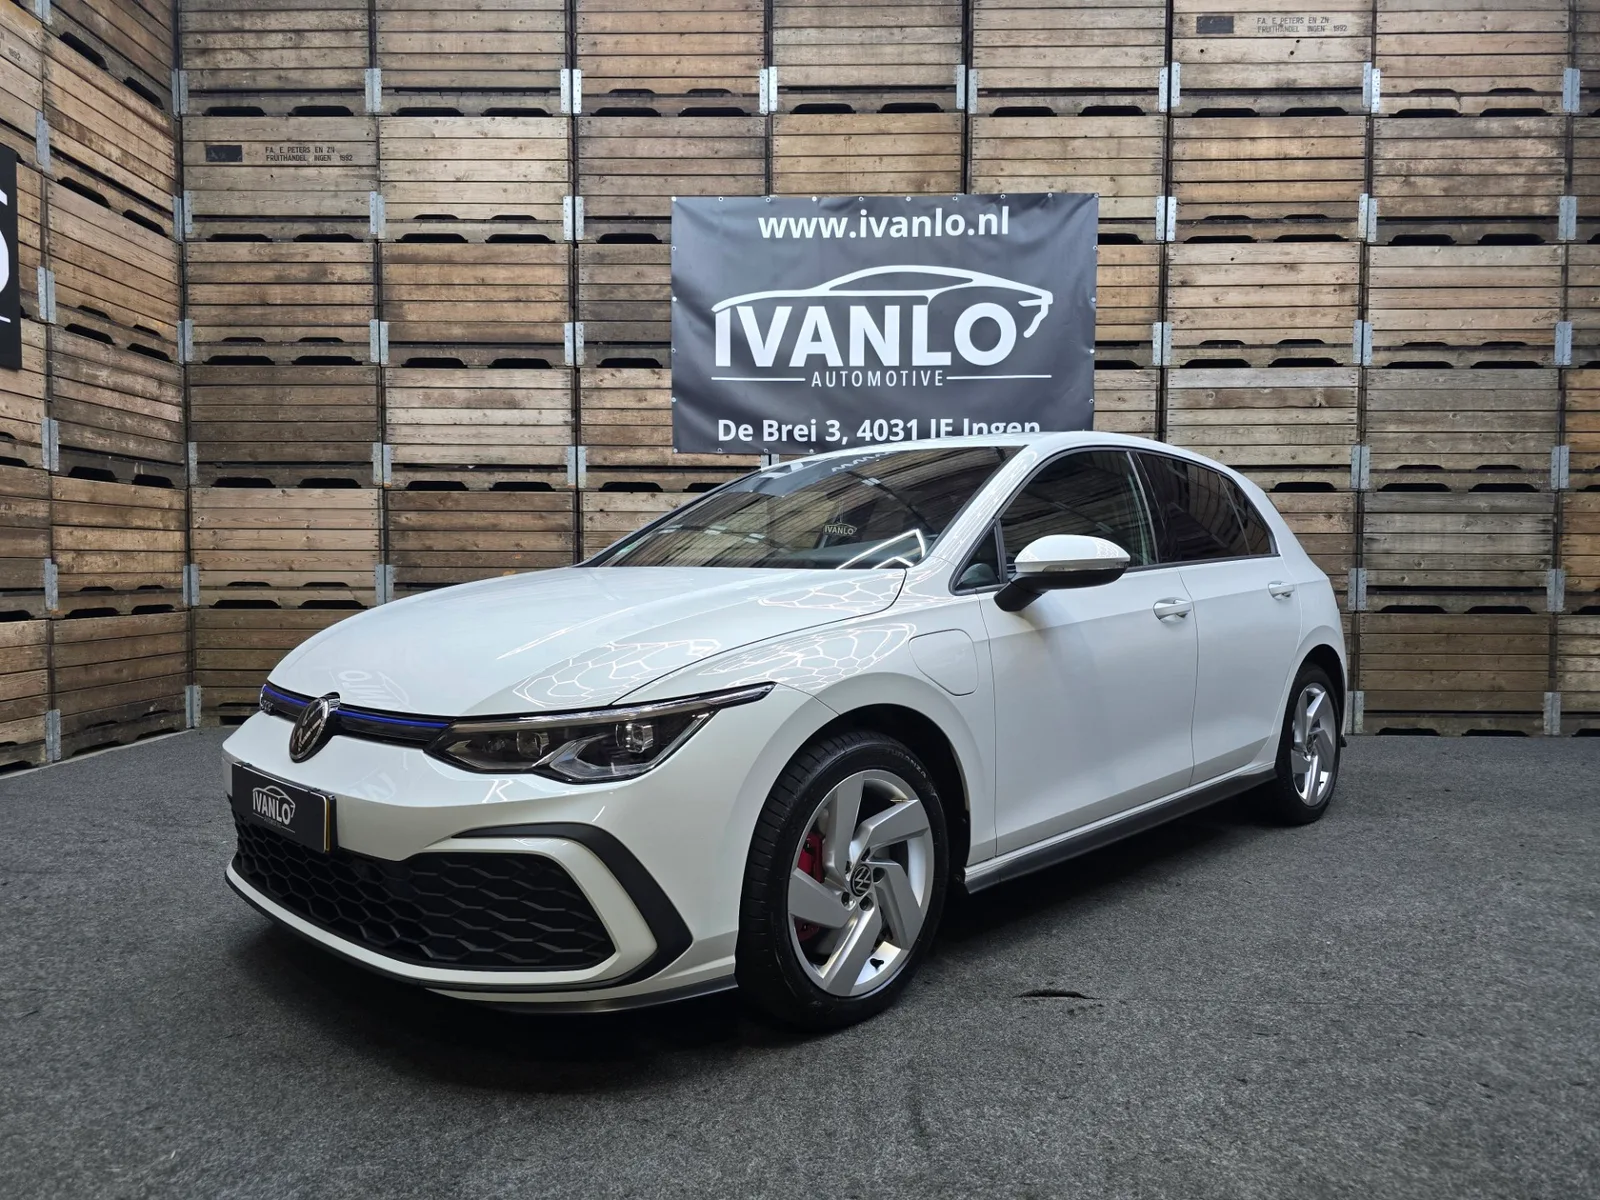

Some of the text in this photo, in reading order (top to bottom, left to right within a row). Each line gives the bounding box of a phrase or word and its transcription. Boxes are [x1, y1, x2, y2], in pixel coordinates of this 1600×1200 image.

[1280, 16, 1305, 24] PETERS
[1308, 16, 1317, 24] EN
[1257, 25, 1300, 33] FRUITHANDEL
[1333, 24, 1348, 32] 1992
[287, 146, 311, 154] PETERS
[314, 146, 324, 154] EN
[266, 154, 307, 162] FRUITHANDEL
[313, 154, 332, 162] INGEN
[758, 206, 1010, 239] www.ivanlo.nl
[714, 302, 1018, 367] IVANLO
[811, 370, 943, 387] AUTOMOTIVE
[717, 419, 754, 442] De
[762, 418, 817, 442] Brei
[825, 419, 849, 446] 3,
[856, 418, 918, 442] 4031
[824, 525, 854, 535] IVANLO
[252, 791, 291, 825] IVANLO
